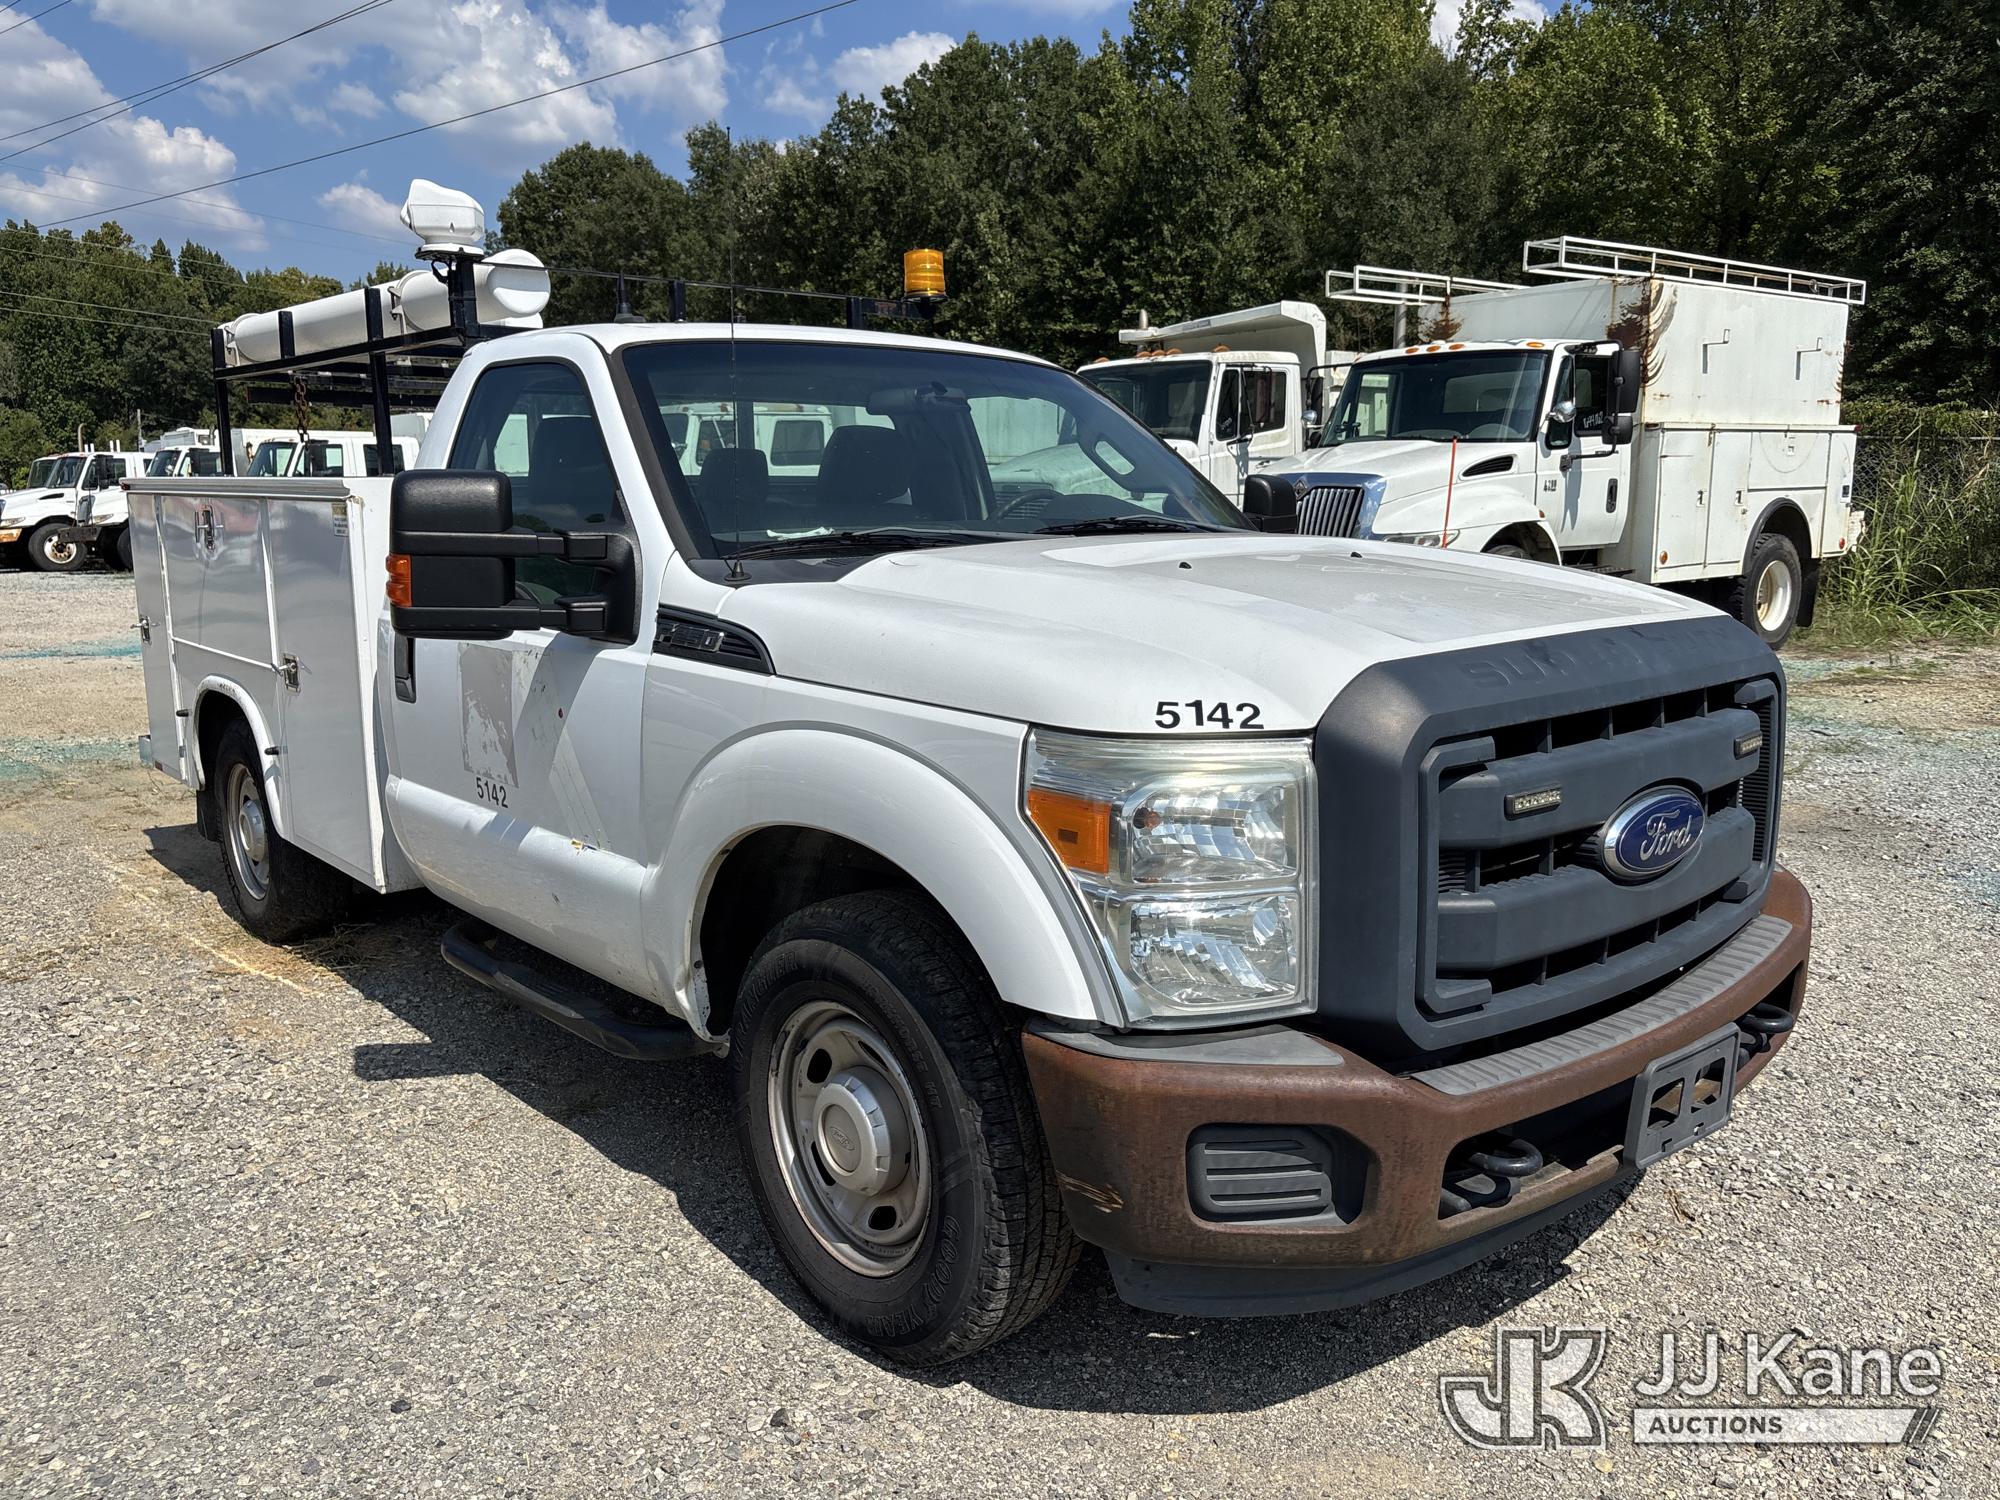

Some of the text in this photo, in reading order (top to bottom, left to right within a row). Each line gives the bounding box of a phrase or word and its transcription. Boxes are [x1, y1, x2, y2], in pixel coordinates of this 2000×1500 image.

[1154, 699, 1265, 730] 5142
[476, 776, 508, 809] 5142
[1639, 808, 1693, 861] Ford
